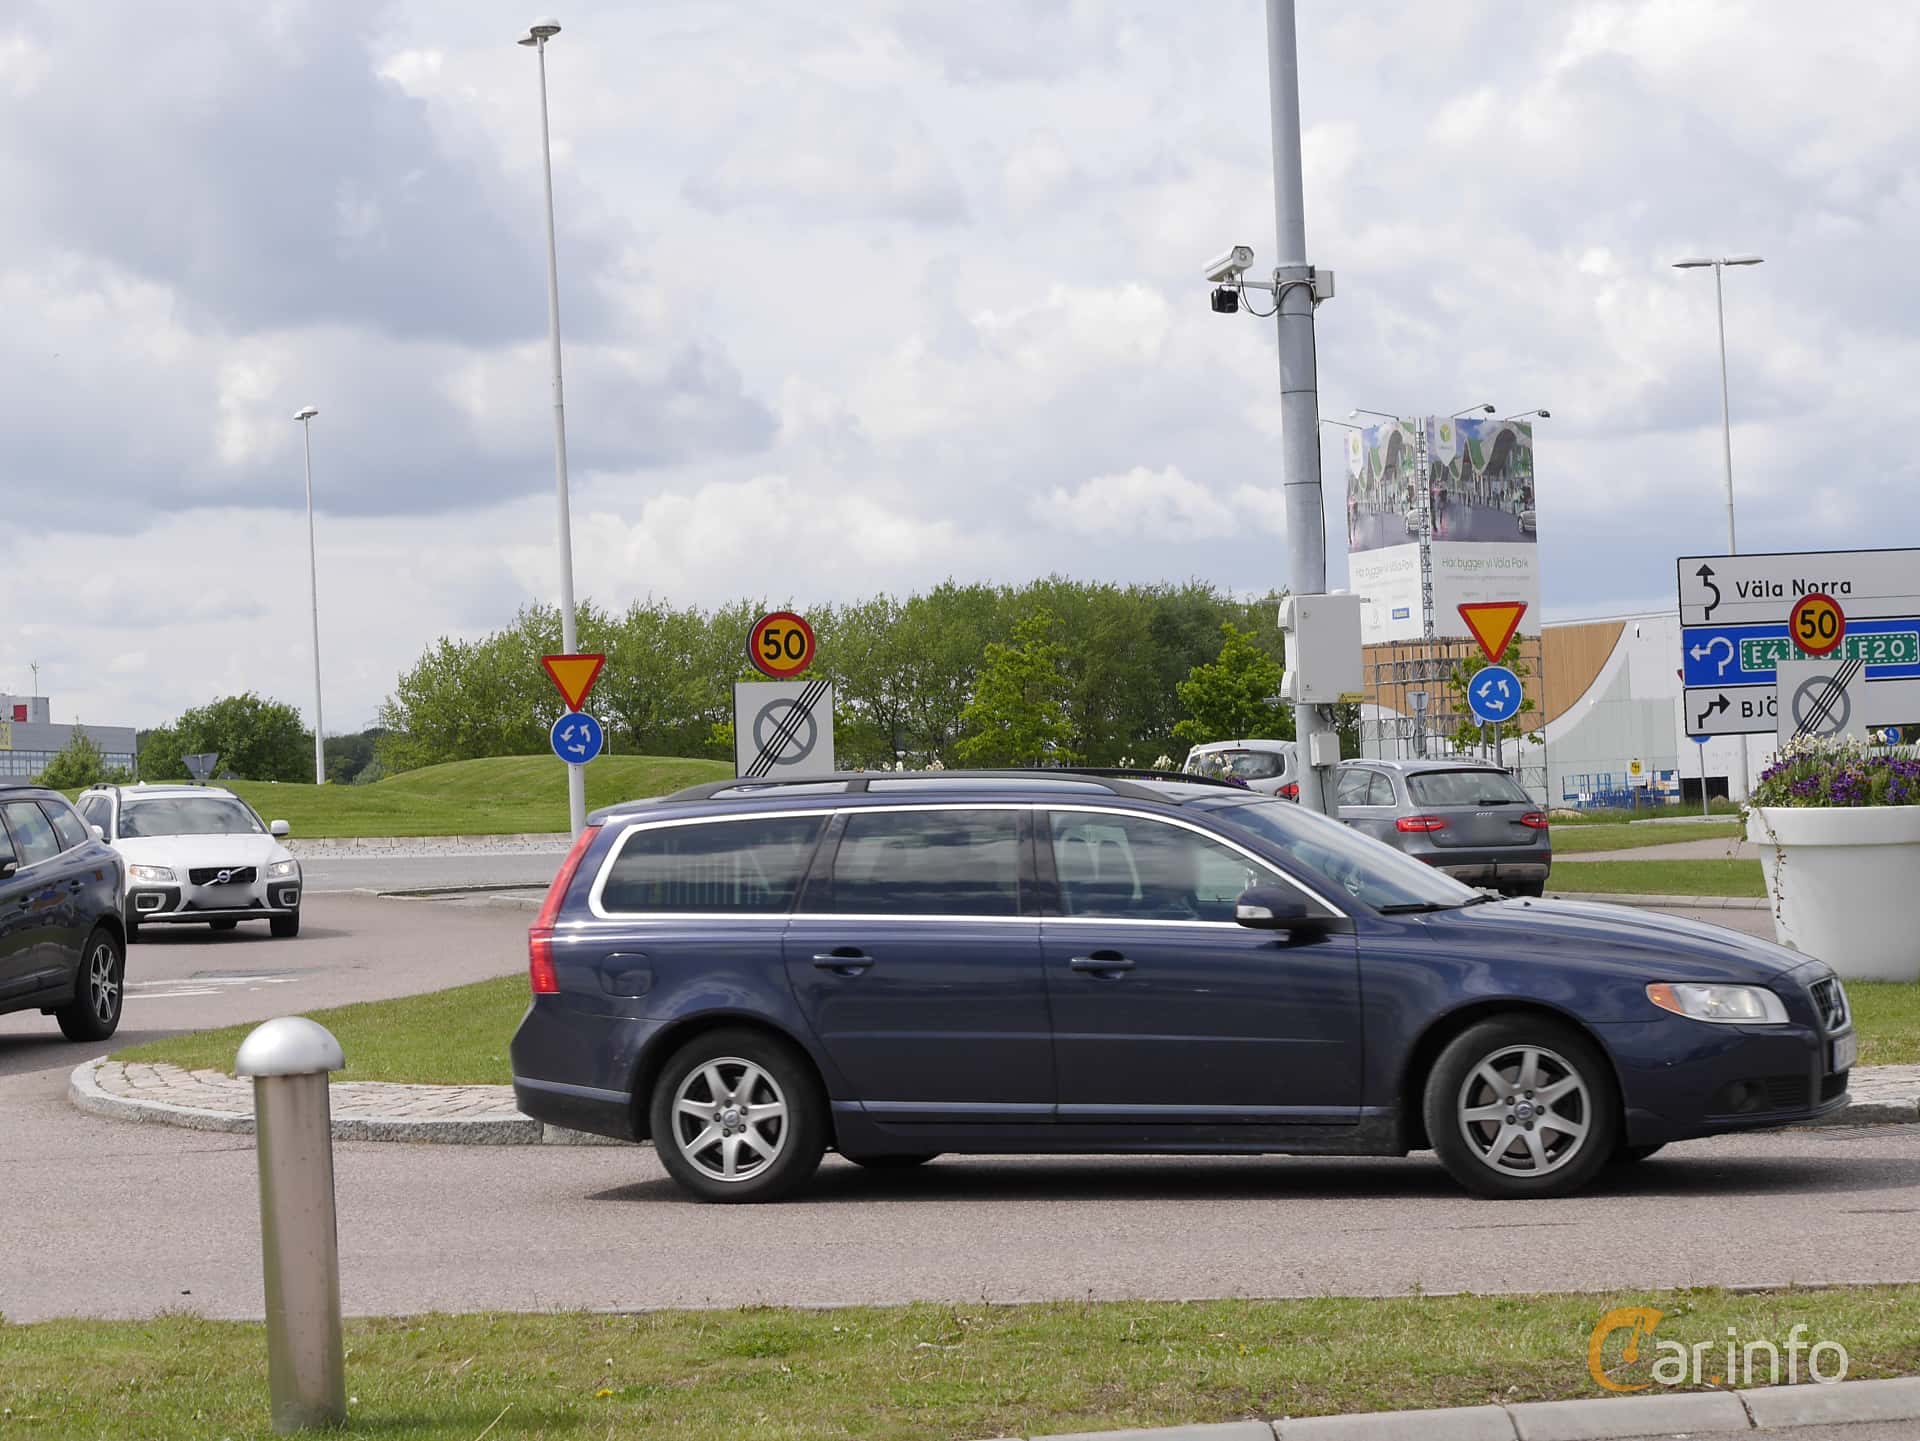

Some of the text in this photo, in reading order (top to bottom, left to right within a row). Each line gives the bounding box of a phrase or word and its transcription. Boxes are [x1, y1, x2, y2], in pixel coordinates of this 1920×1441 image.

[1736, 578, 1851, 598] Väla Norra
[1800, 609, 1837, 639] 50
[763, 629, 806, 661] 50
[1752, 640, 1905, 664] E4 E20
